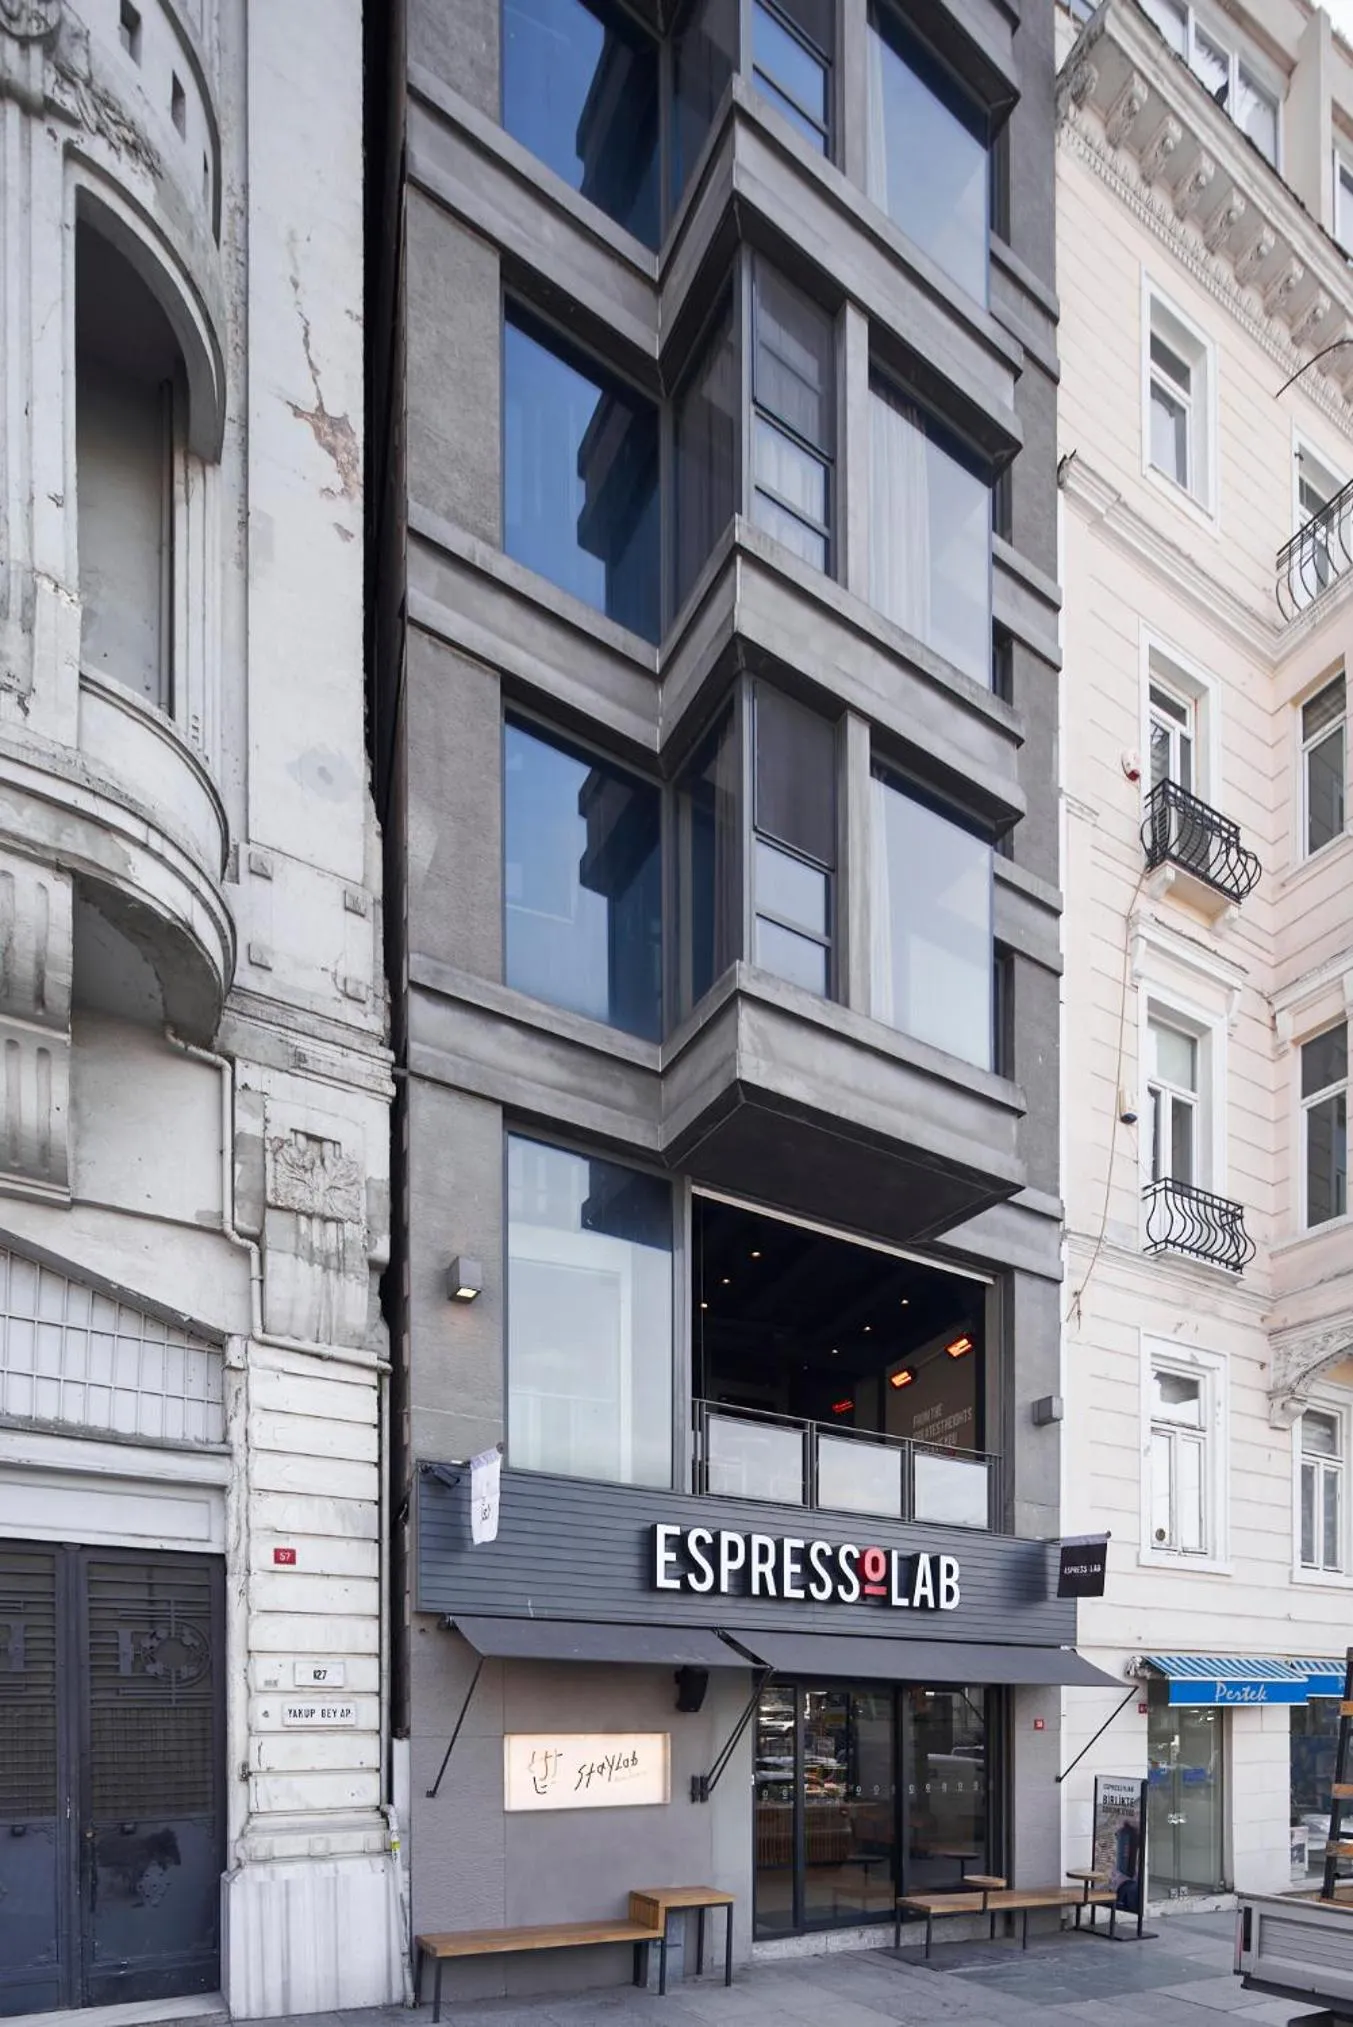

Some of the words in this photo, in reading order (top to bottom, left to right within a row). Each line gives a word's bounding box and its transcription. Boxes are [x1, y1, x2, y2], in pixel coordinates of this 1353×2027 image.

[654, 1523, 961, 1610] ESPRESSOLAB
[1214, 1681, 1267, 1702] Pertek
[288, 1708, 316, 1719] YAKUP
[321, 1708, 337, 1719] BEY
